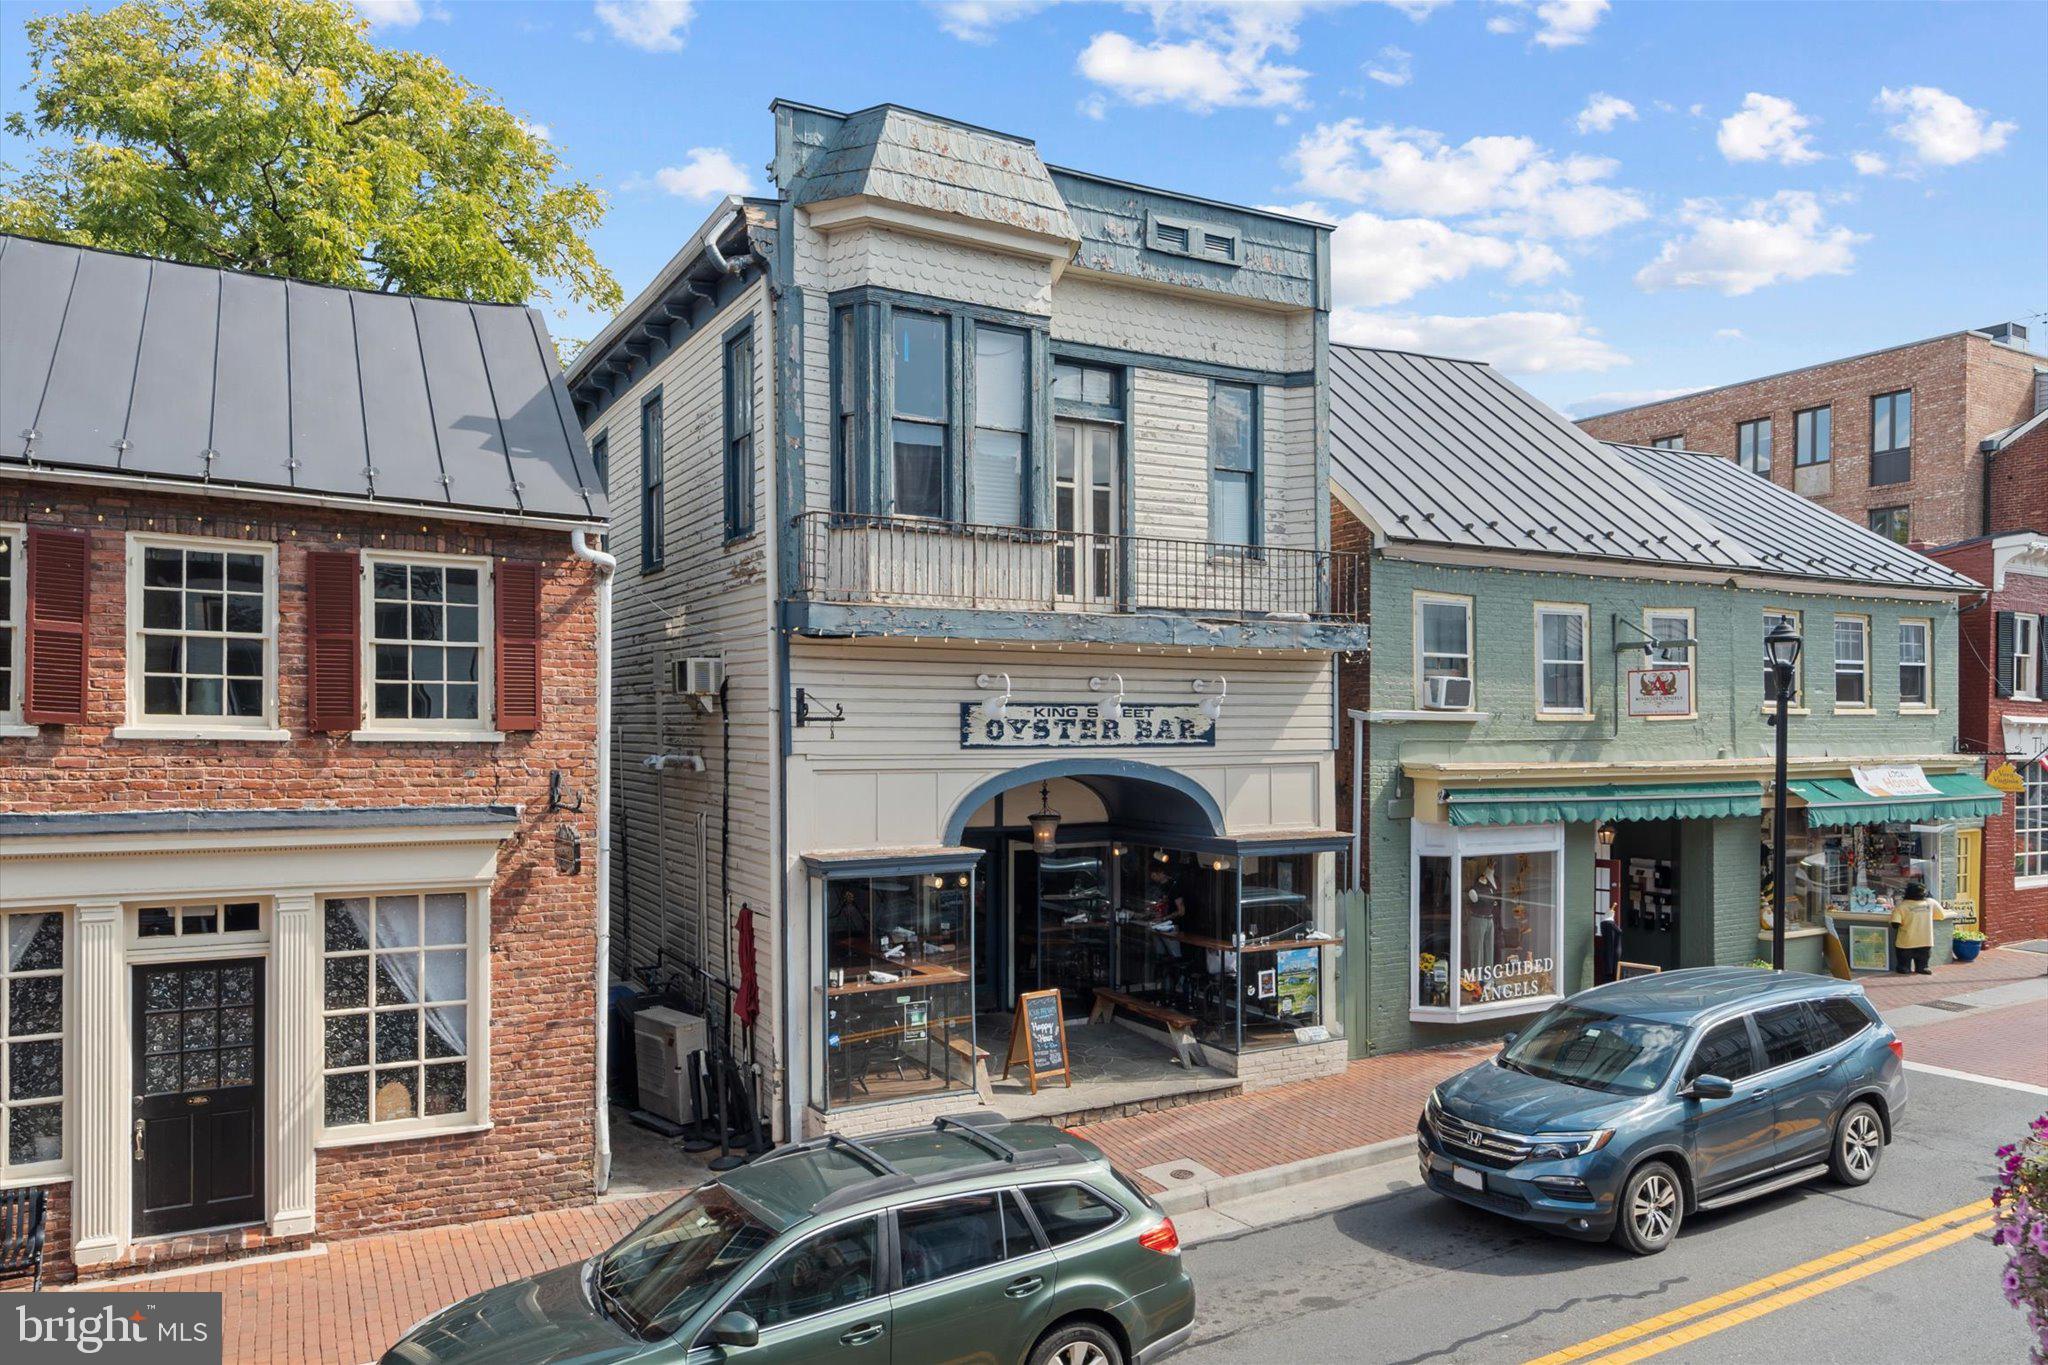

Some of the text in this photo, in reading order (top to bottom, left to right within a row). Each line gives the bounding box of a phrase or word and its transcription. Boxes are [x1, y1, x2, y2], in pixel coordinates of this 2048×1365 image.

[1033, 708, 1154, 718] KING SEET
[985, 719, 1199, 740] OYSTER BAR
[1463, 957, 1554, 982] MISGUIDED
[1480, 980, 1539, 1002] ANGELS
